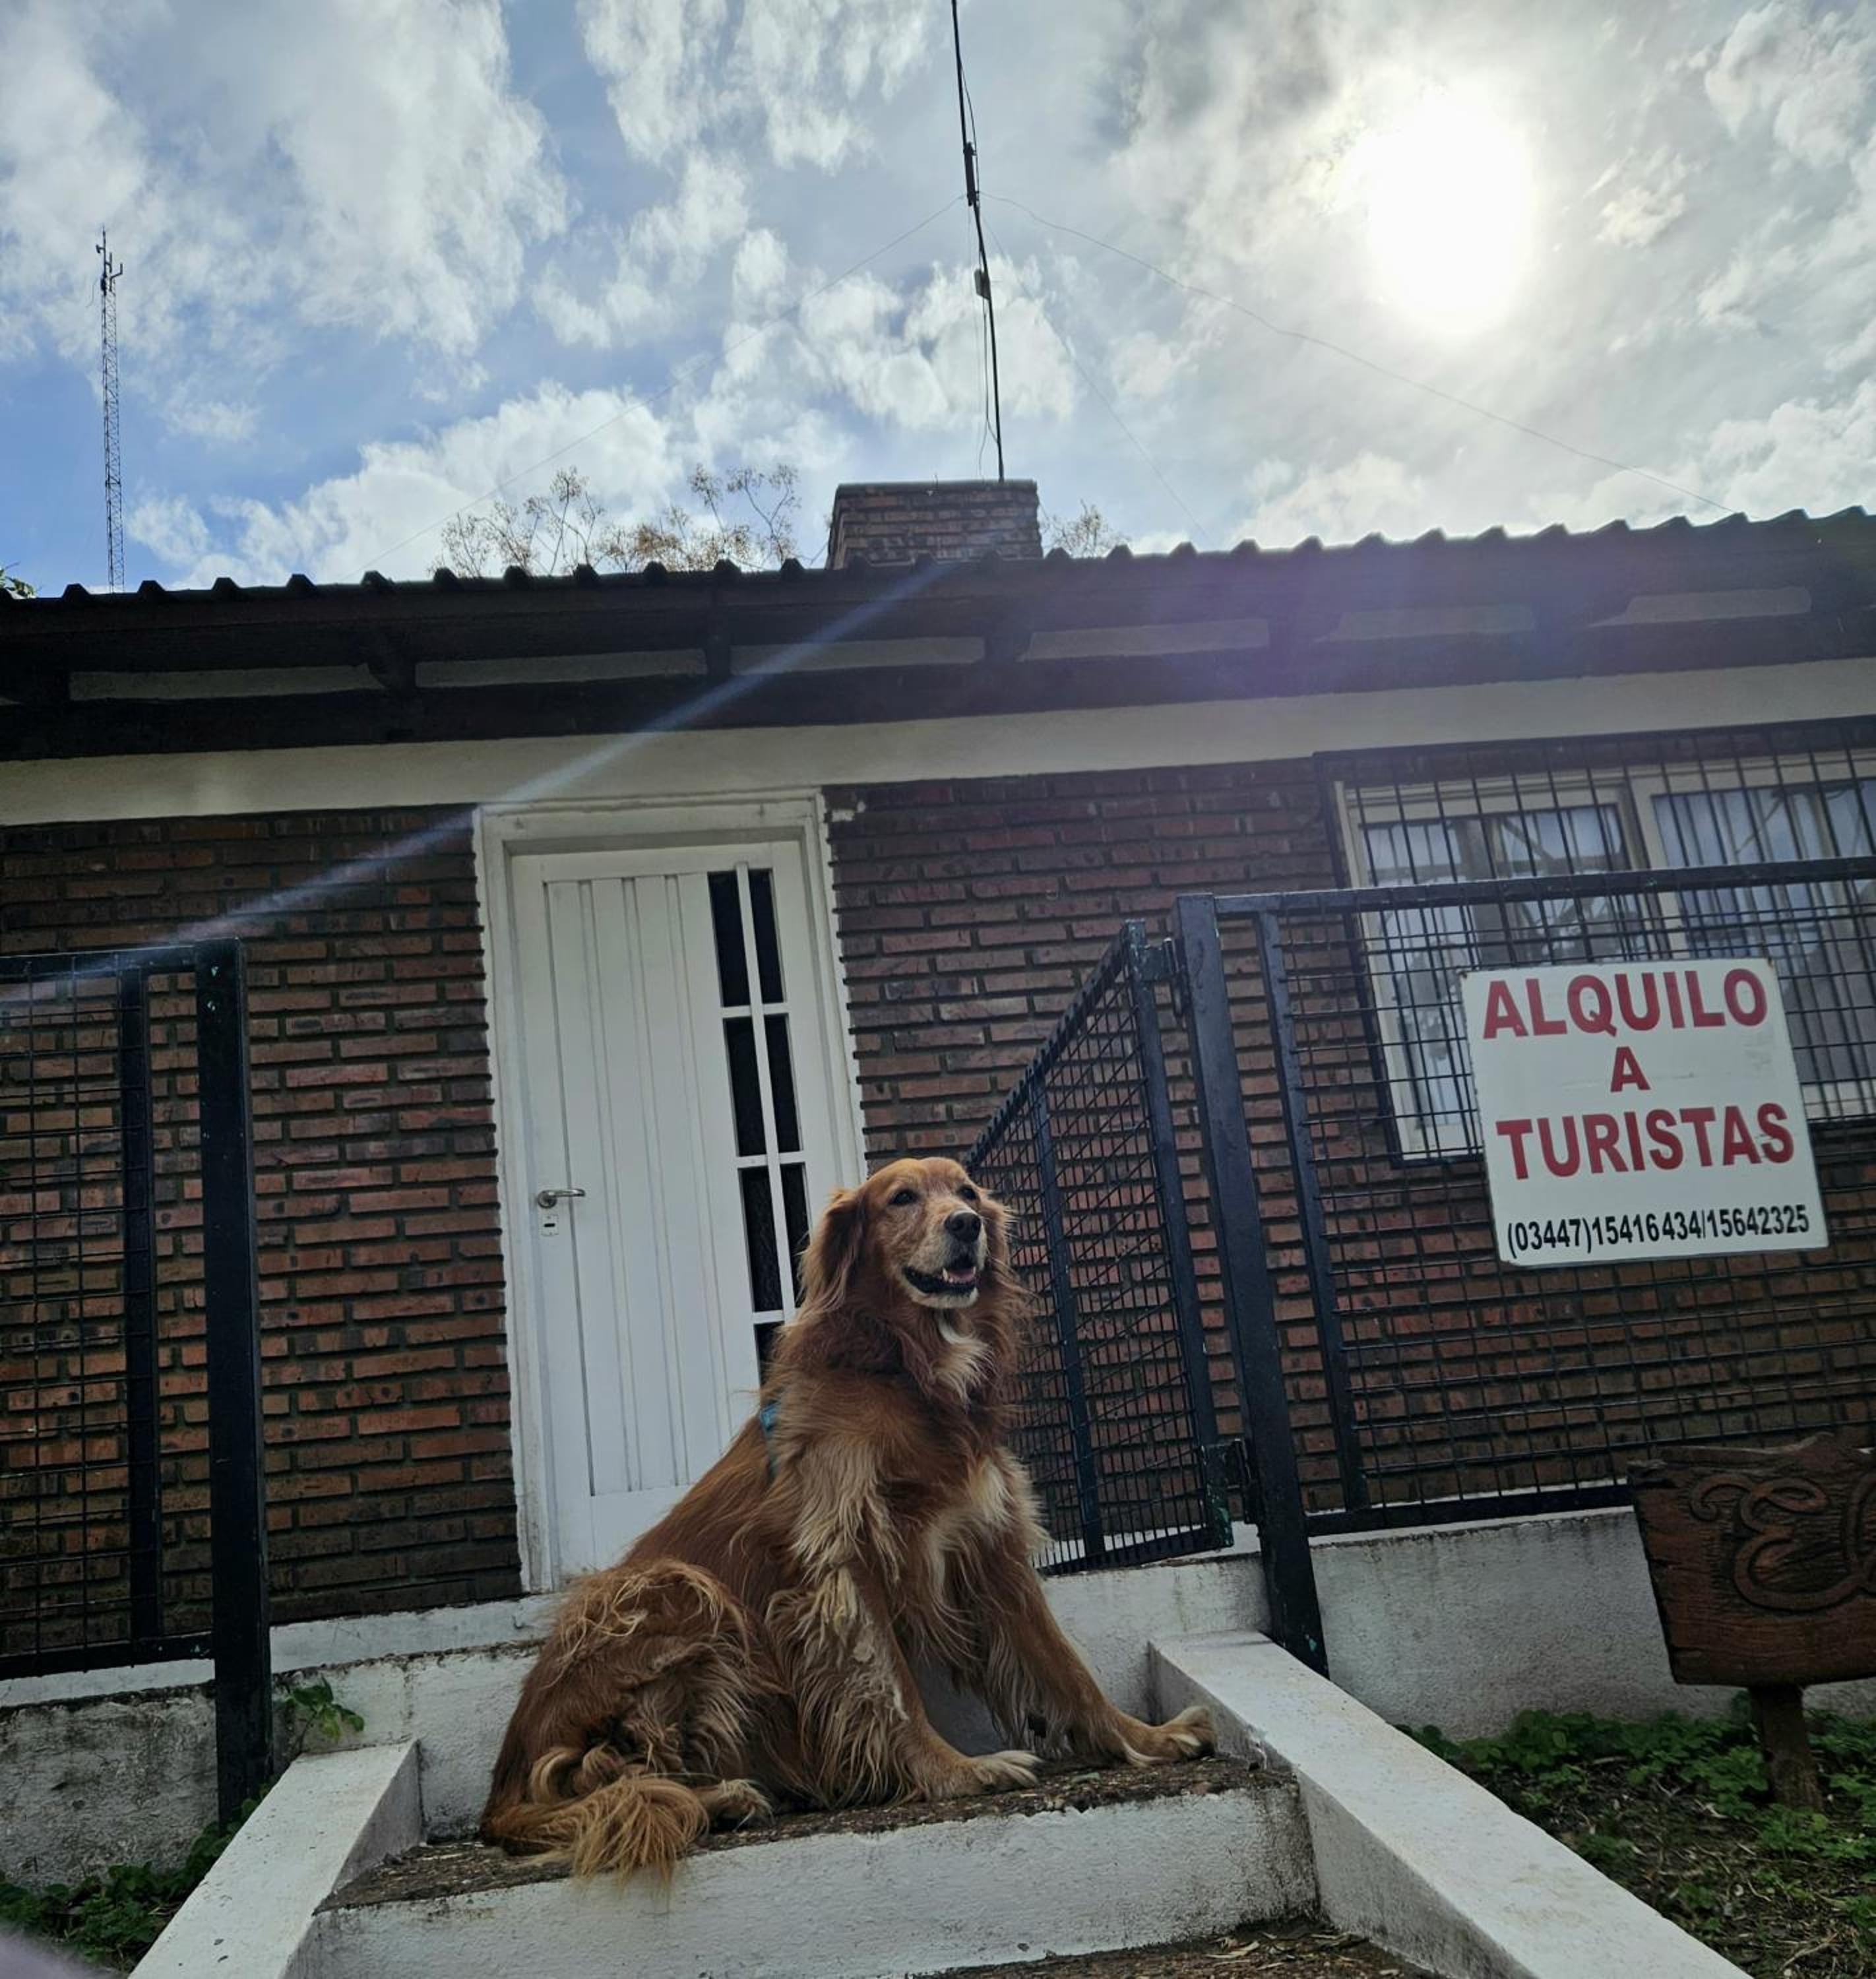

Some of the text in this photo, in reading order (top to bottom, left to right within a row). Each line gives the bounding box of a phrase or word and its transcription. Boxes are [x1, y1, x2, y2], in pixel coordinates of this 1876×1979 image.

[1483, 968, 1768, 1039] ALQUILO
[1610, 1046, 1650, 1092] A
[1495, 1103, 1794, 1179] TURISTAS
